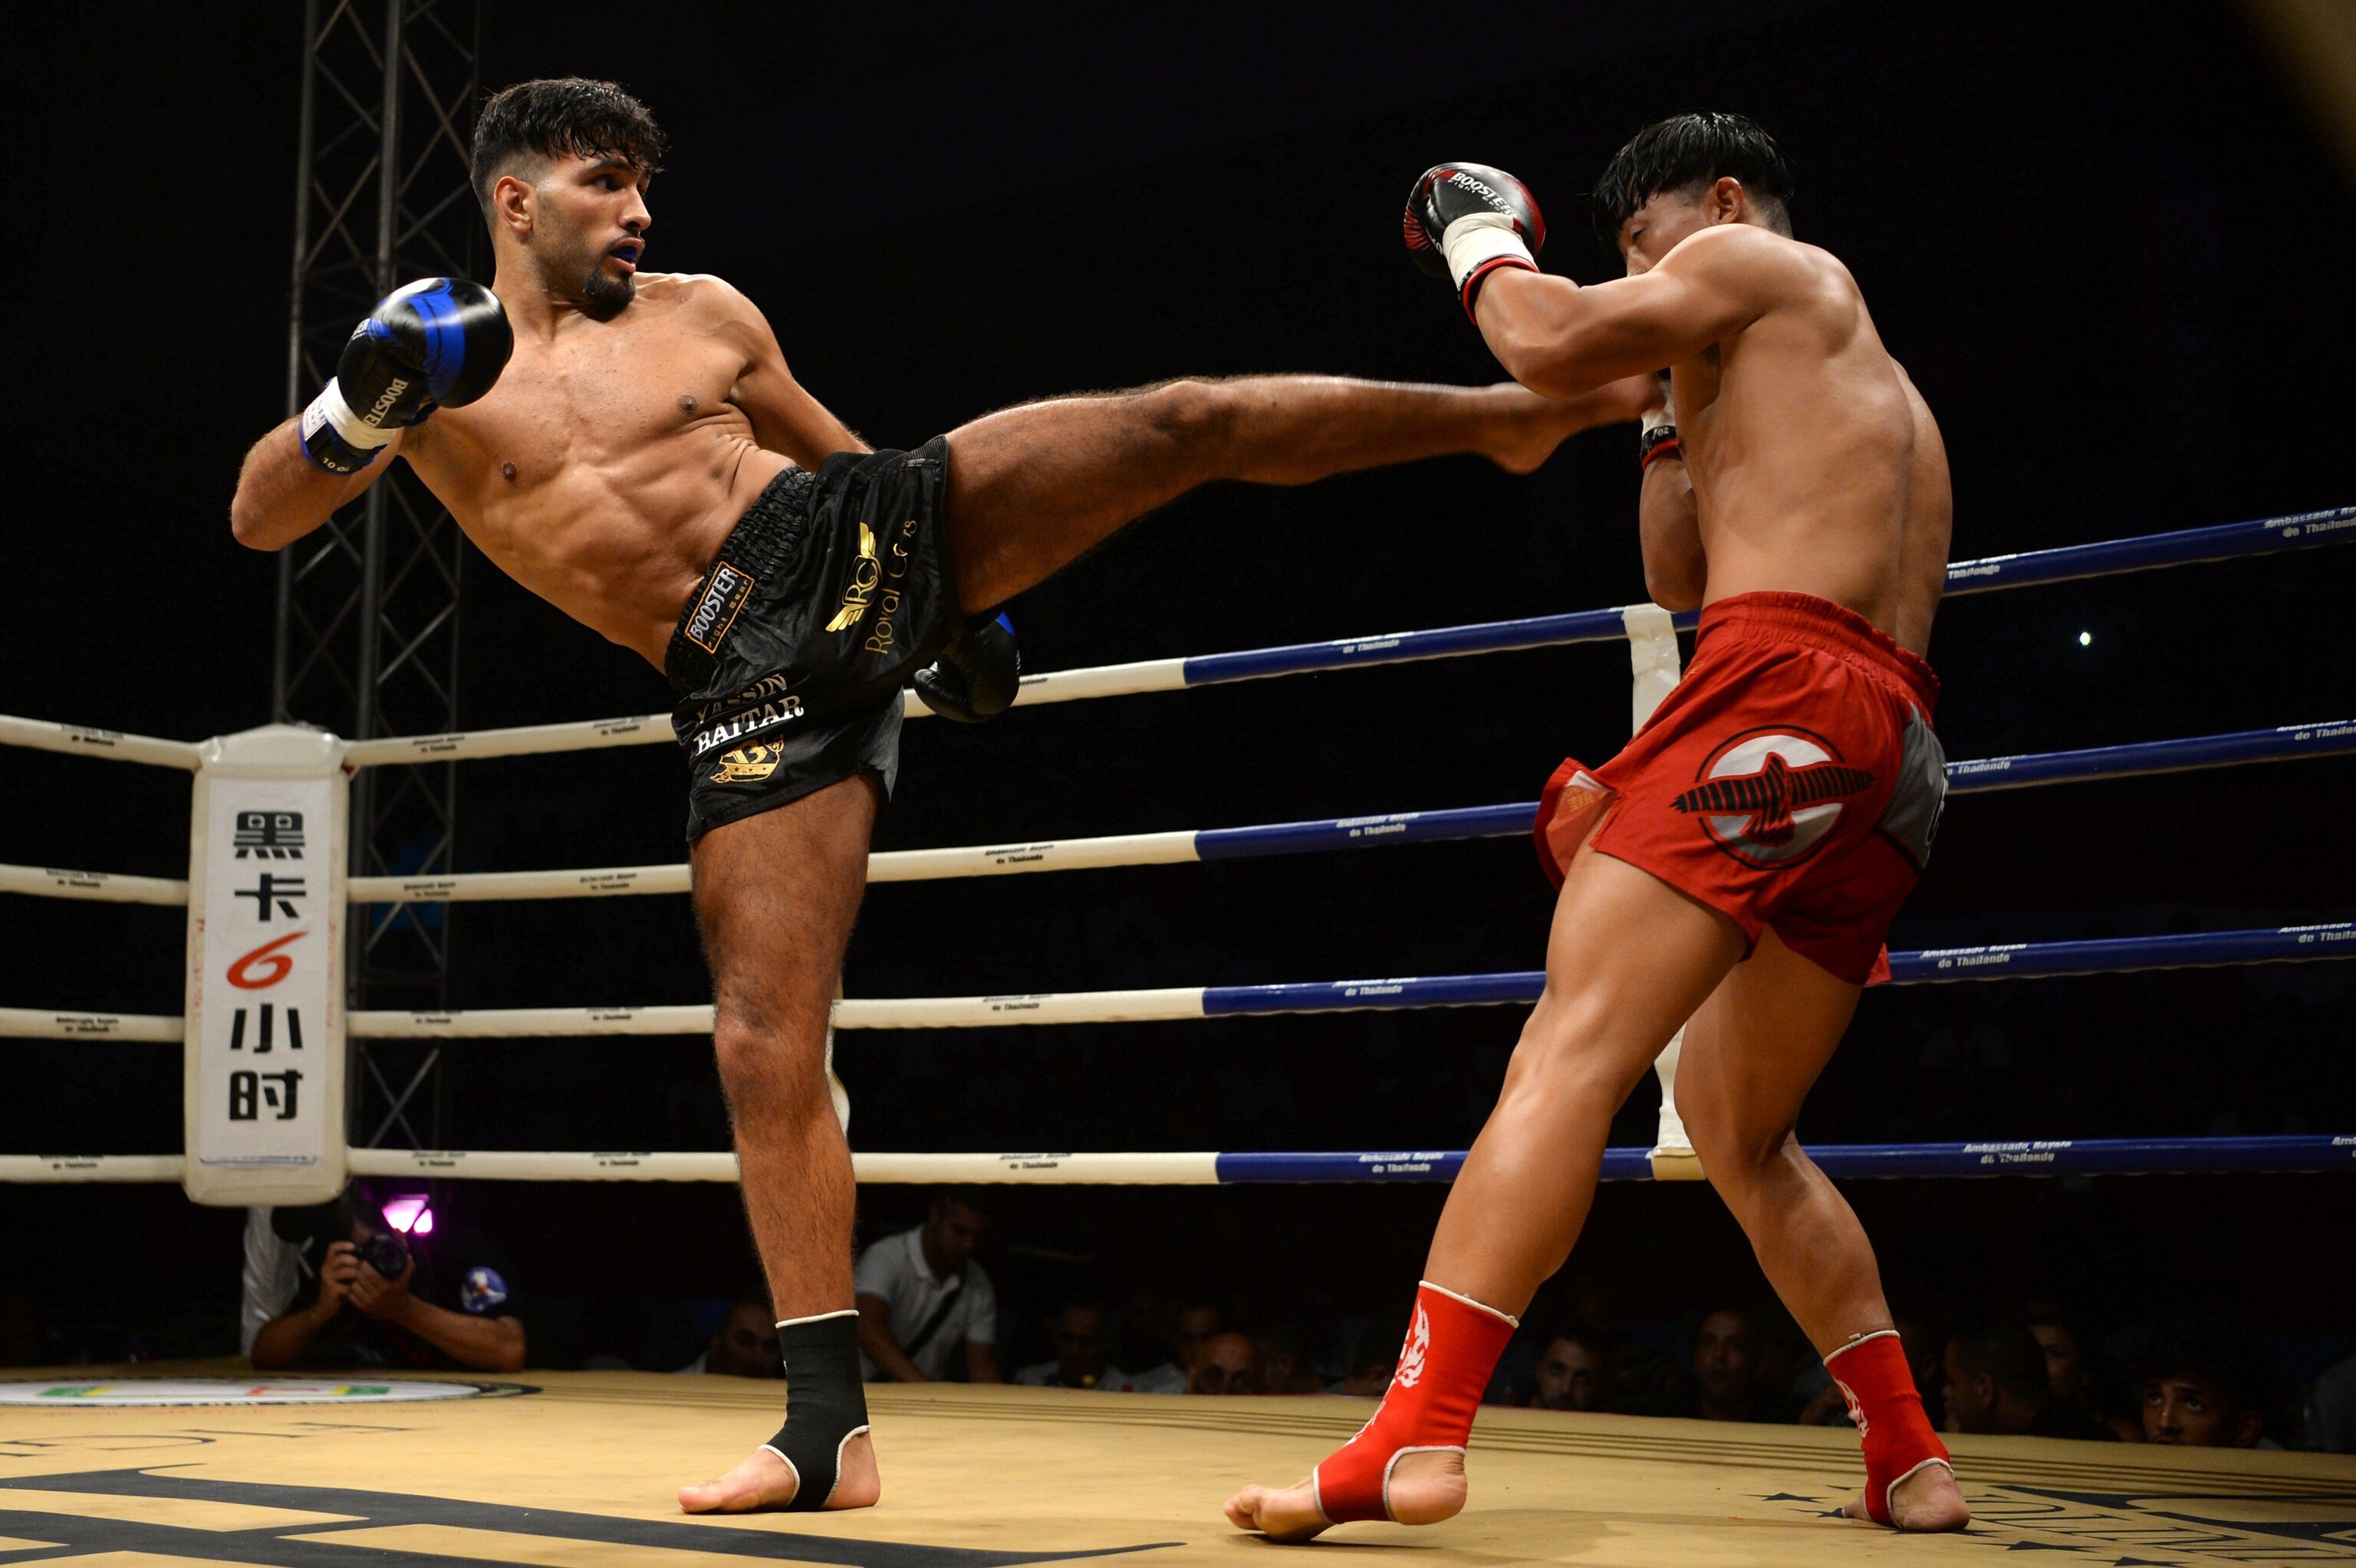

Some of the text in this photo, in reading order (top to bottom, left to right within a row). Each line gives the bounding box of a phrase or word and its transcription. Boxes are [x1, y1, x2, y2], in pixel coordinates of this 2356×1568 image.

[363, 377, 409, 429] BOOSTE
[690, 568, 739, 642] BOOSTER
[693, 695, 805, 756] BAITAR
[227, 811, 310, 1121] 黑卡6小时
